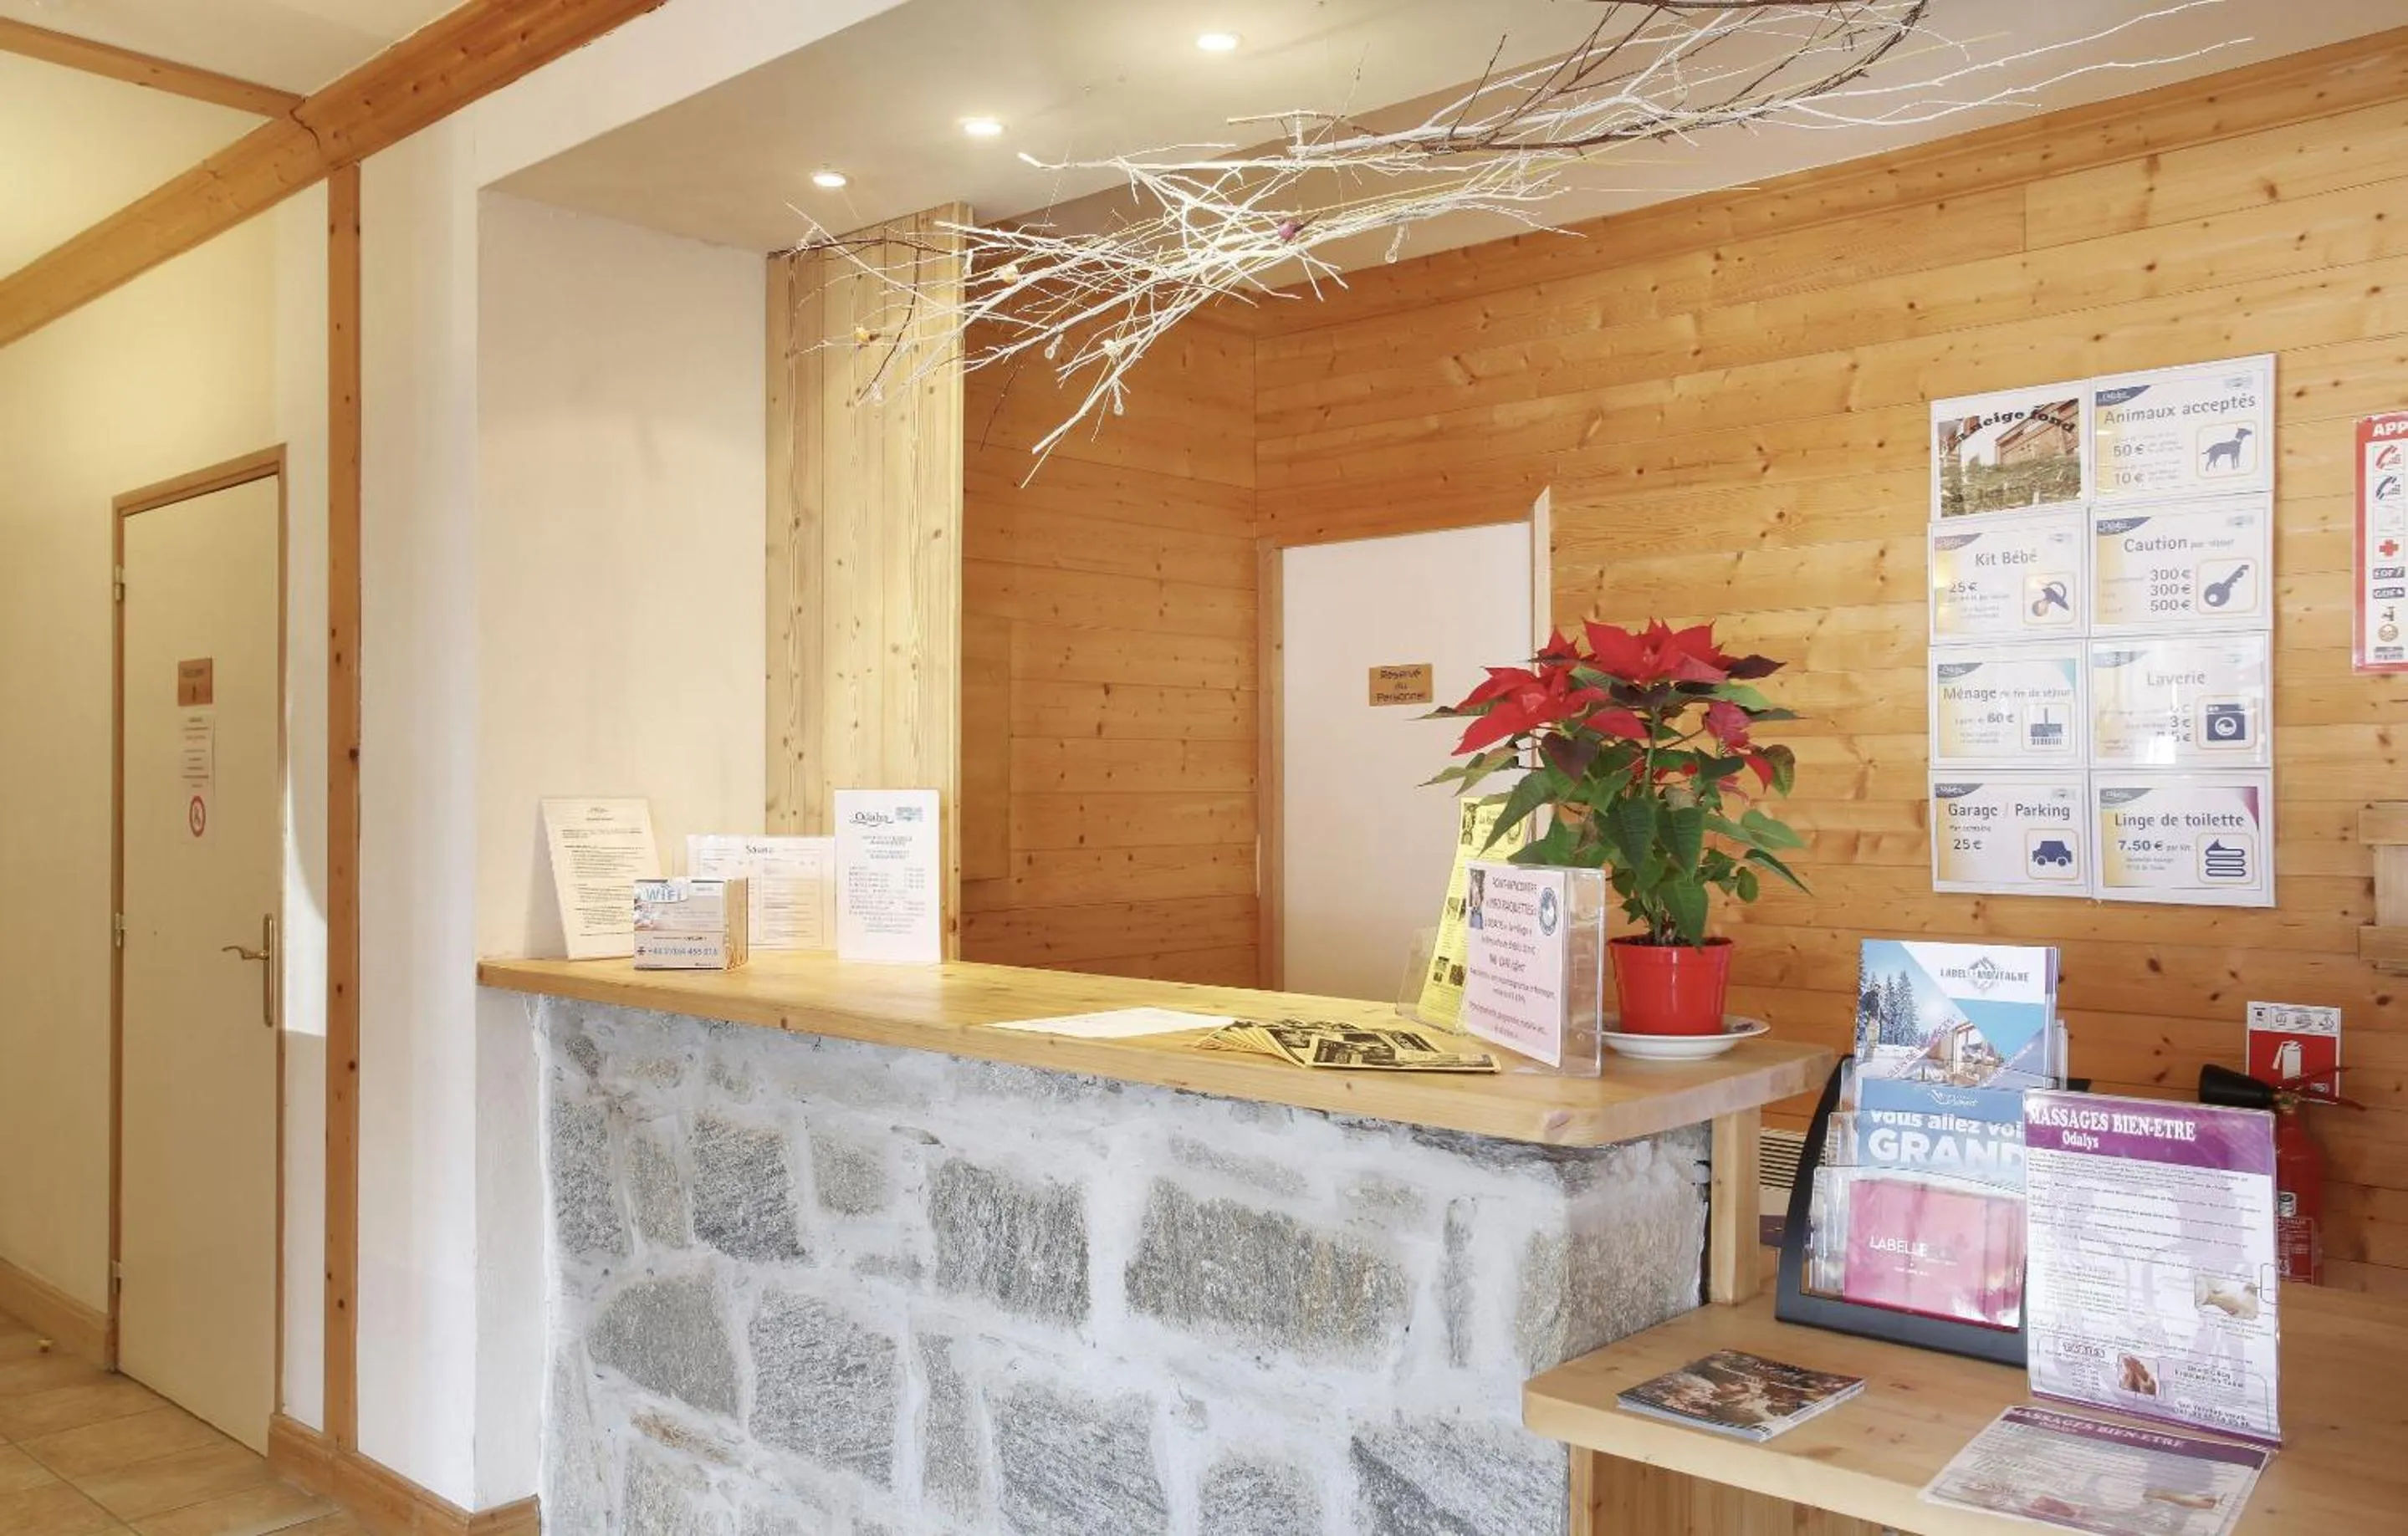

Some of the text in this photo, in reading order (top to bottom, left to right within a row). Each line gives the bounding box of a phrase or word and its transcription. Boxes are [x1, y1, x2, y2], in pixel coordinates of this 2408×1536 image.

[2104, 393, 2256, 424] Animaux acceptés
[2124, 535, 2187, 552] Caution
[1976, 549, 2037, 566] Kit Bébé
[2147, 671, 2206, 686] Laverie
[1943, 686, 1996, 702] Ménage
[1948, 804, 1998, 820] Garage
[2015, 804, 2070, 820] Parking
[2114, 813, 2245, 830] Linge de toilette
[1870, 1110, 1923, 1127] vous
[1927, 1113, 1981, 1134] allez
[2111, 1114, 2196, 1141] BIEN-ETRE
[2062, 1130, 2099, 1150] Odalys
[1869, 1128, 2024, 1171] GRAND
